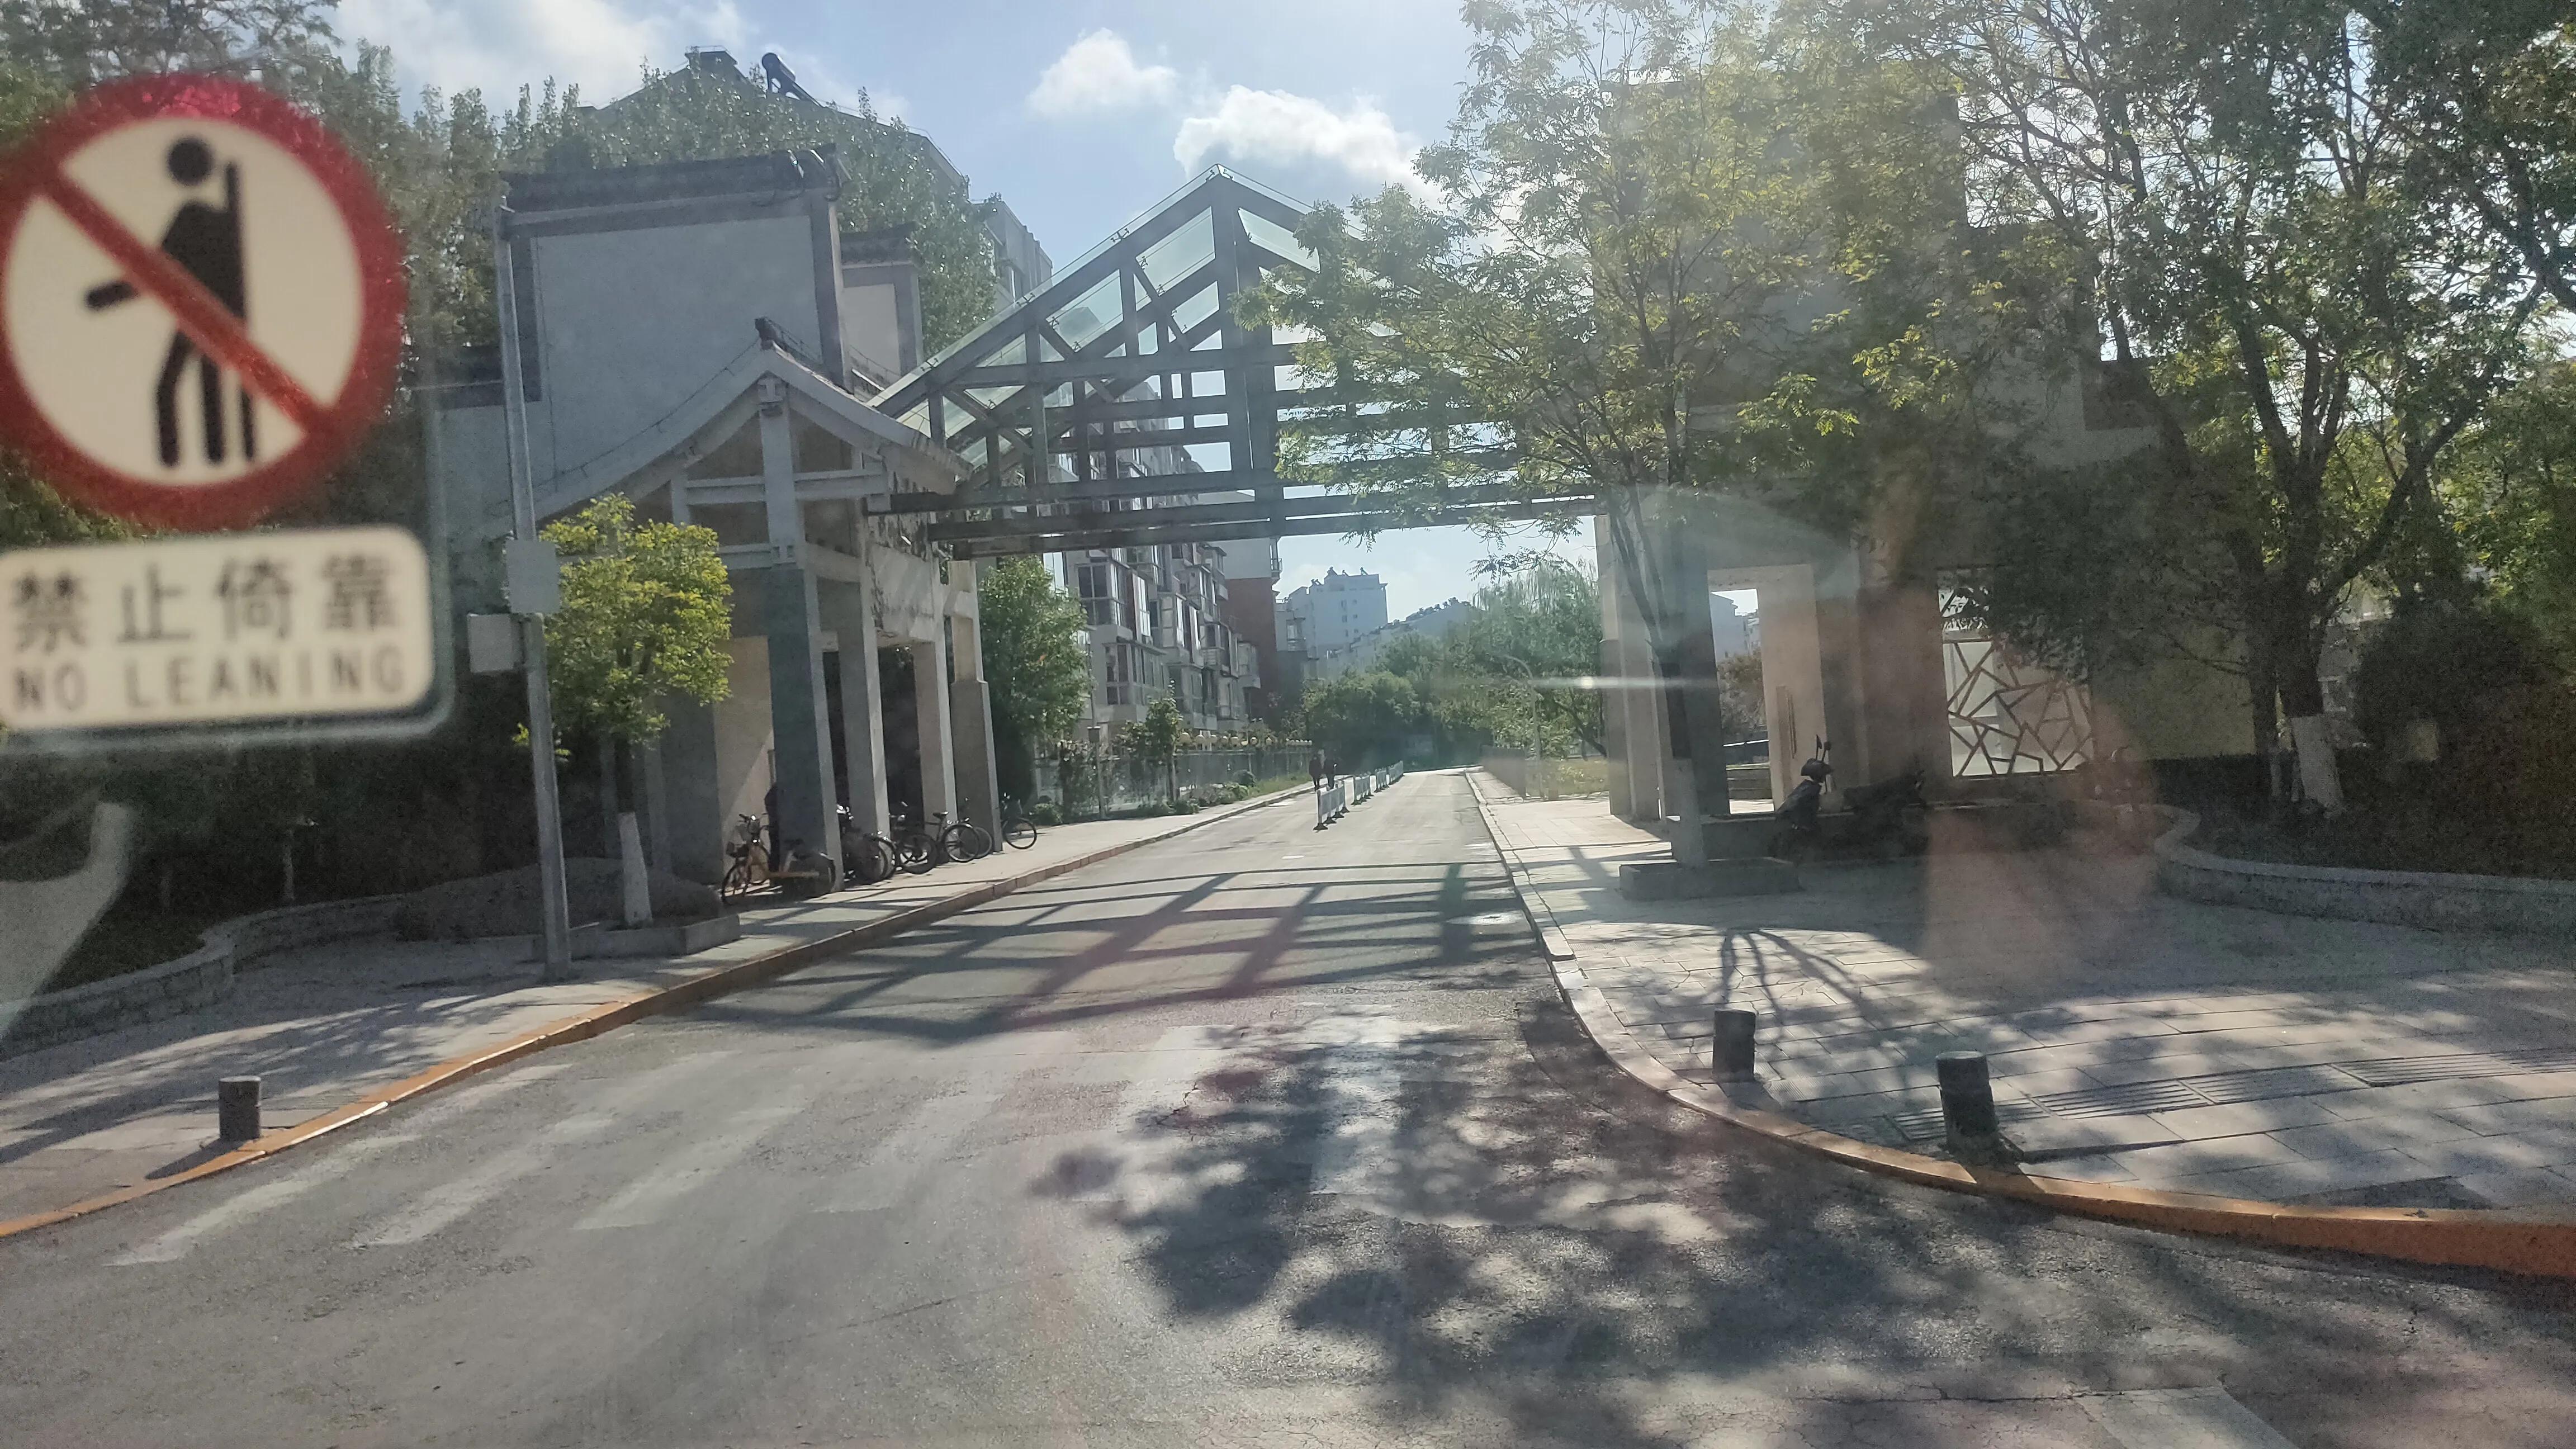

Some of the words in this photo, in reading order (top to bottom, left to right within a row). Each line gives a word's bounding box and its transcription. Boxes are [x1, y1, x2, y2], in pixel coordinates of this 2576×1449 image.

[10, 555, 399, 654] 禁止倚靠
[13, 662, 87, 712] NO
[124, 643, 404, 708] LEANING
